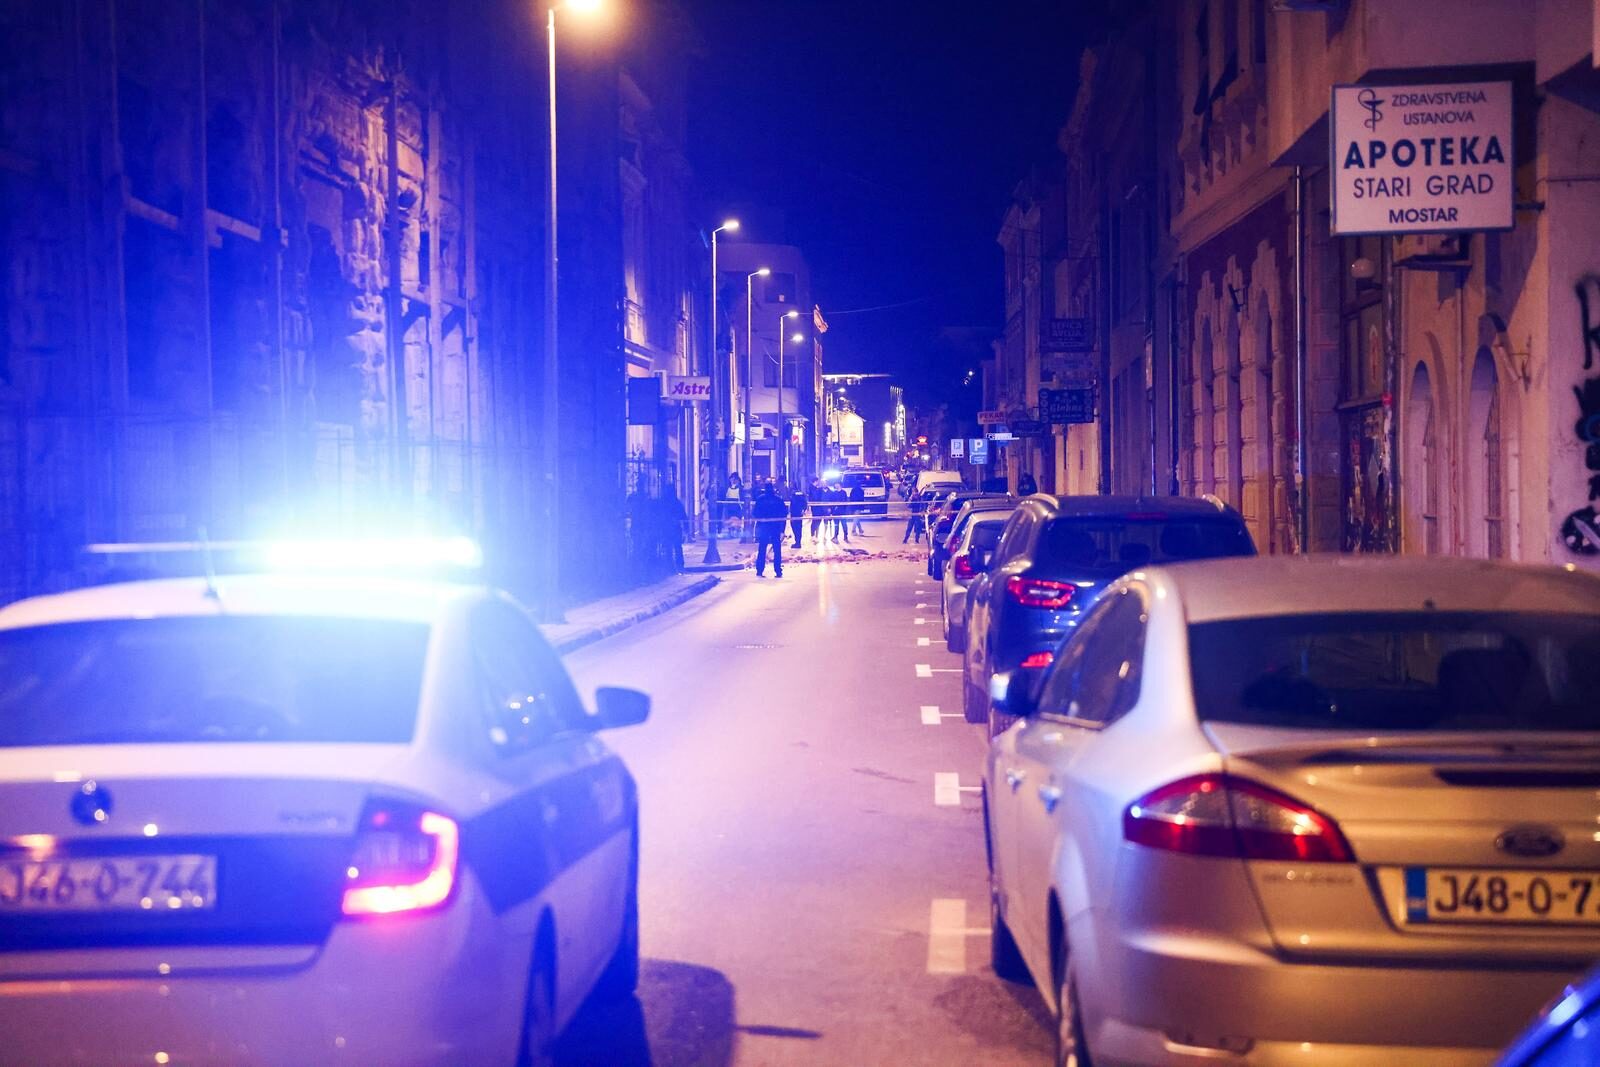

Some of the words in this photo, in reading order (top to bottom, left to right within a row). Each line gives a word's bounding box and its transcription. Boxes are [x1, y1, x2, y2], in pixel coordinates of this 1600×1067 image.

[1391, 90, 1487, 107] ZDRAVSTVENA
[1403, 111, 1475, 126] USTANOVA
[1343, 135, 1505, 169] APOTEKA
[1353, 177, 1411, 199] STARI
[1426, 173, 1494, 196] GRAD
[1388, 207, 1458, 223] MOSTAR
[974, 439, 983, 451] P
[1434, 875, 1600, 916] J48-0-7
